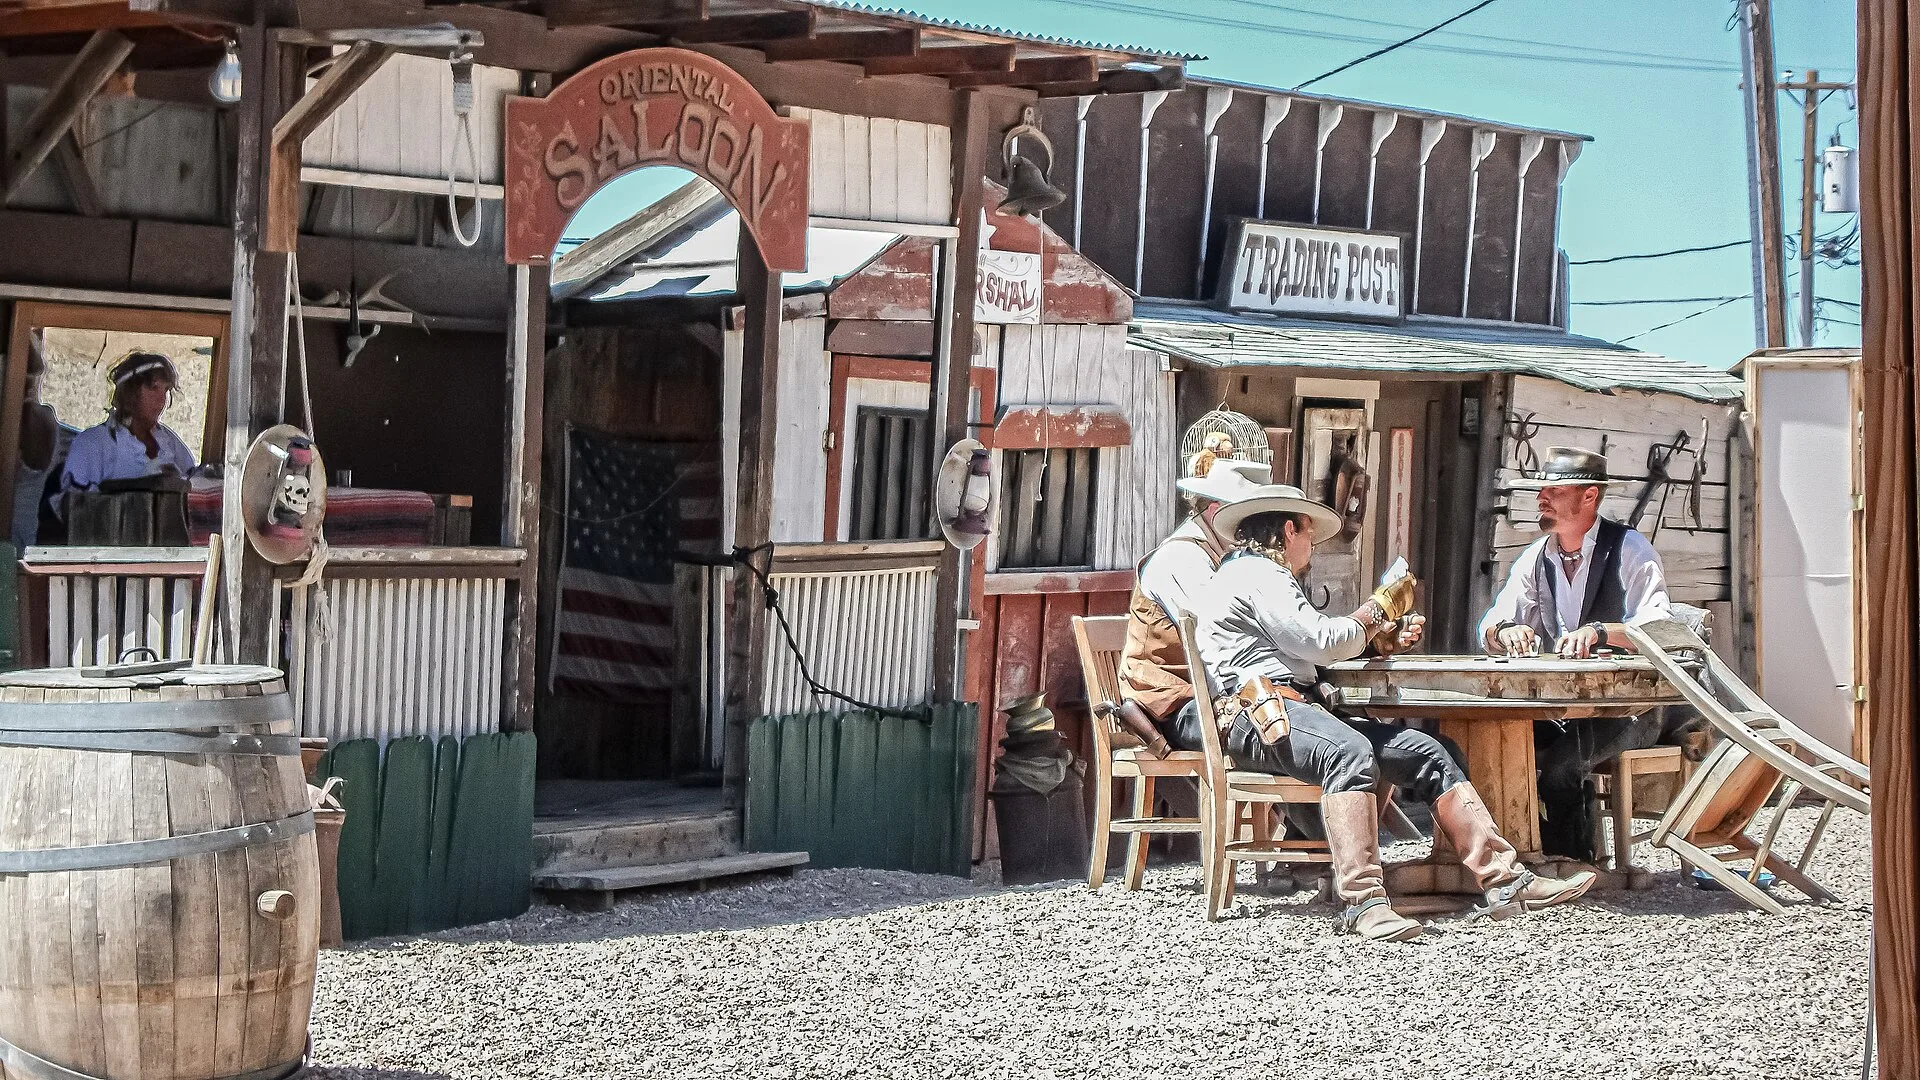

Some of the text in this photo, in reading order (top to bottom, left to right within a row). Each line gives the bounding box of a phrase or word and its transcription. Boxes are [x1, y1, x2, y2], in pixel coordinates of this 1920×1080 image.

[600, 62, 734, 116] ORIENTAL
[545, 99, 788, 228] SALOON
[977, 268, 1037, 312] RSHAL
[1241, 232, 1399, 306] TRADING POST
